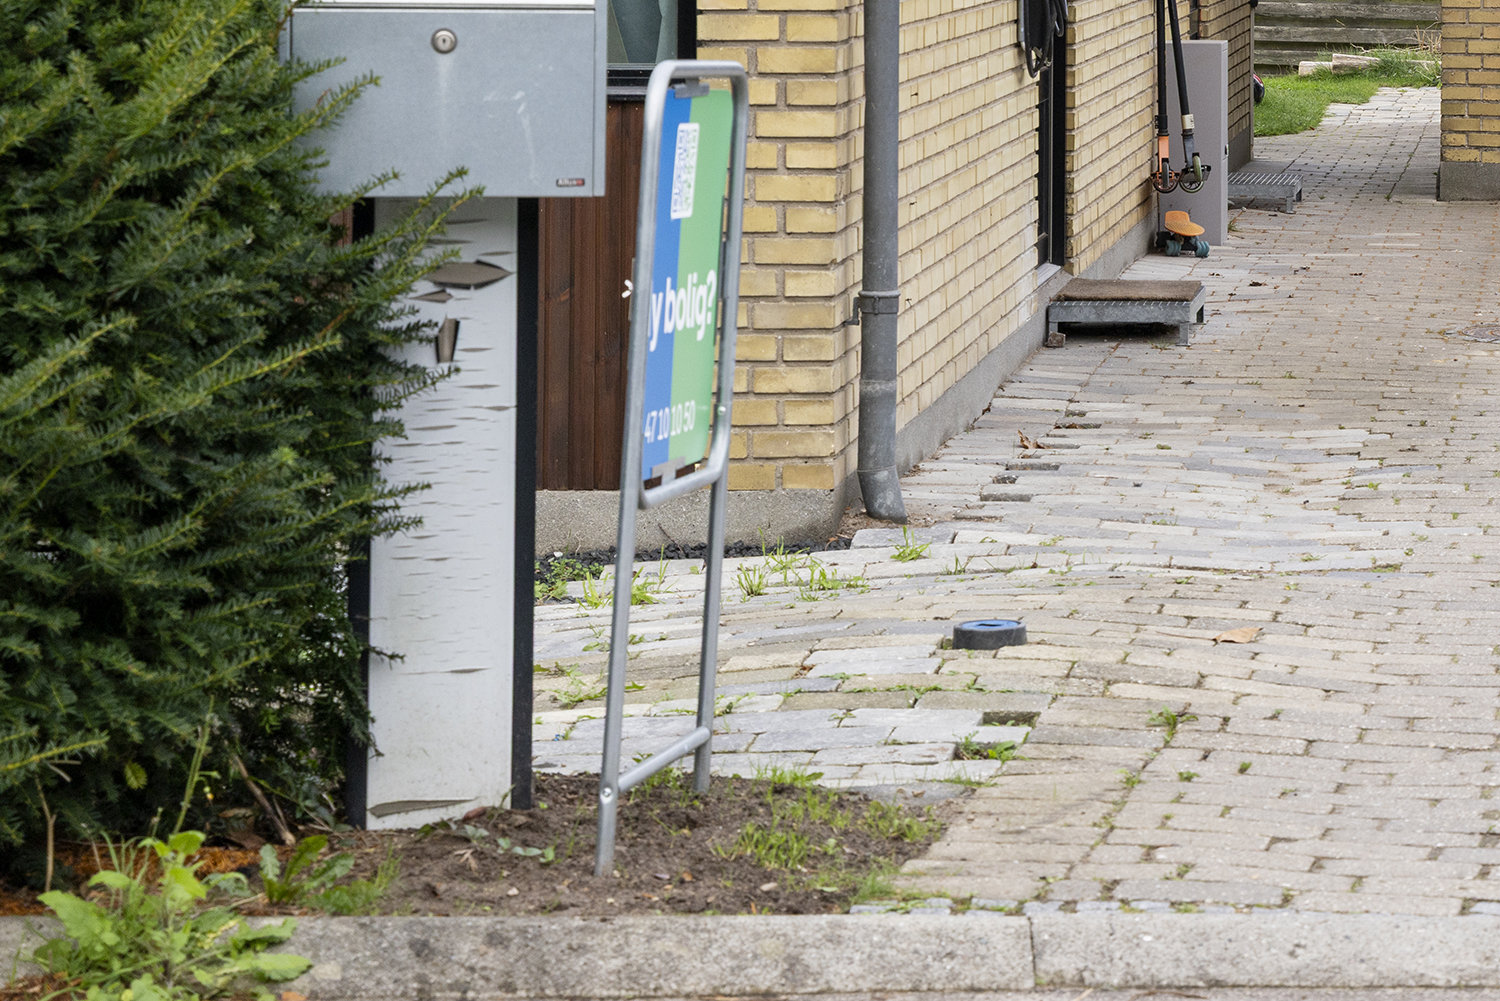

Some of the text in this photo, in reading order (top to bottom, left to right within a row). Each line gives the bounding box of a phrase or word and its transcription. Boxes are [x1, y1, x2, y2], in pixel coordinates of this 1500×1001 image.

[648, 269, 717, 352] y bolig?
[644, 400, 696, 444] 47 10 10 50
